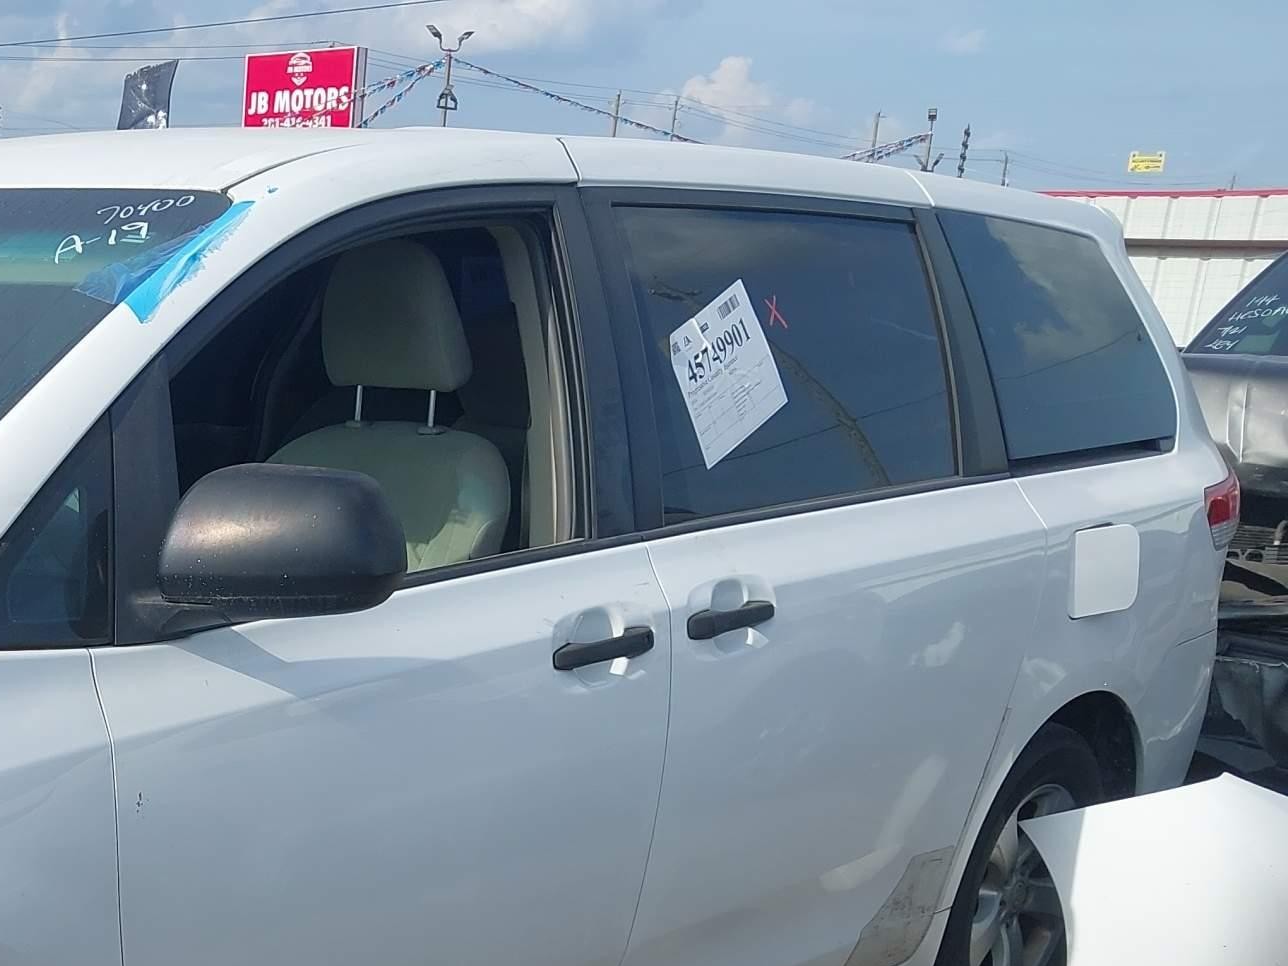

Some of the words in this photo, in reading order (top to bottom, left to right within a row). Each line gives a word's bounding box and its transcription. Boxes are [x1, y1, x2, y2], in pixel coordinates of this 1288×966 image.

[248, 91, 269, 115] JB
[274, 86, 350, 113] MOTORS
[687, 318, 751, 383] 45749901
